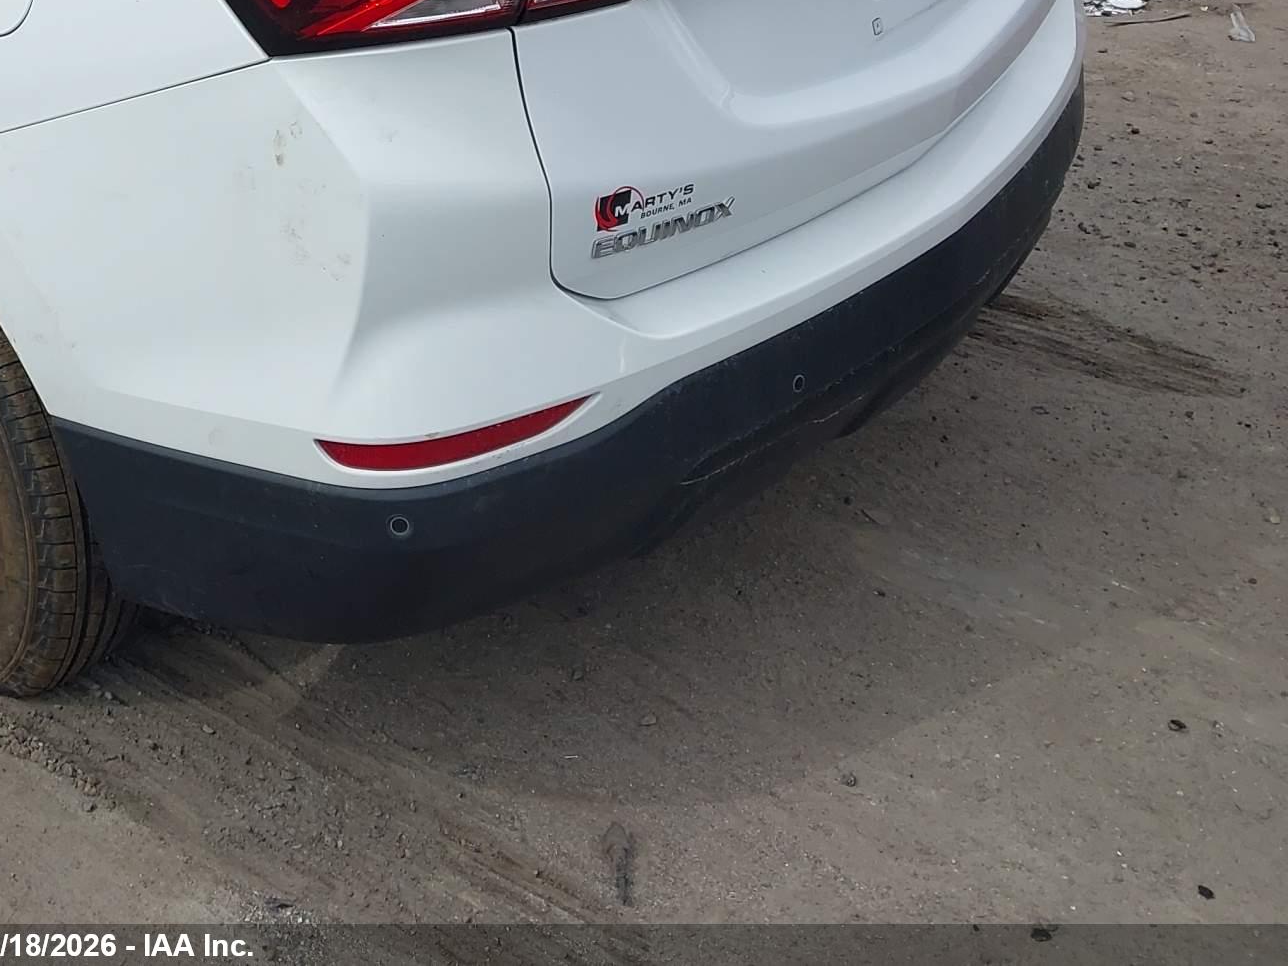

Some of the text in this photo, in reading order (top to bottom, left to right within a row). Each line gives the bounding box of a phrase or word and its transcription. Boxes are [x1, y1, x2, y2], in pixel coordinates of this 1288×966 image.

[614, 183, 694, 218] MARTY'S
[640, 197, 692, 219] BOURNE, MA
[591, 196, 735, 259] EQUINOX
